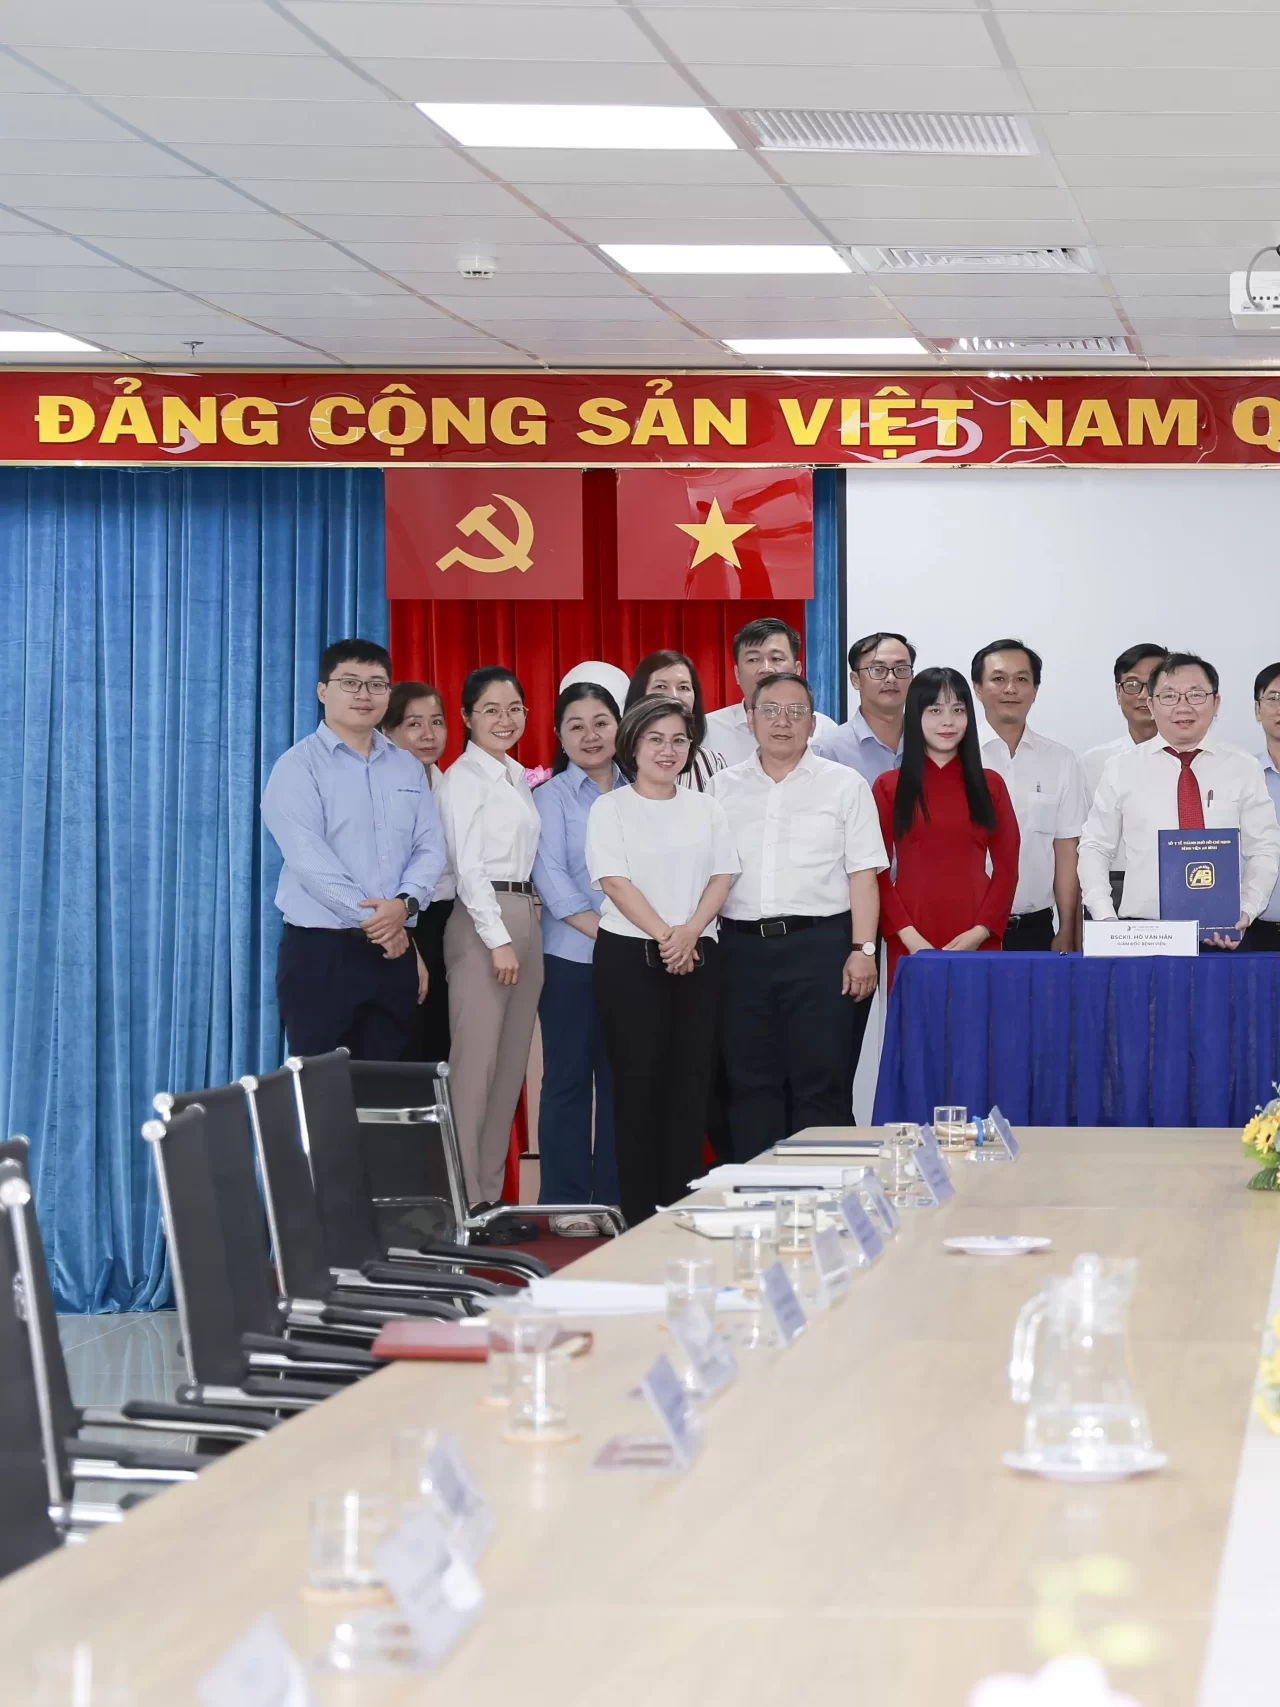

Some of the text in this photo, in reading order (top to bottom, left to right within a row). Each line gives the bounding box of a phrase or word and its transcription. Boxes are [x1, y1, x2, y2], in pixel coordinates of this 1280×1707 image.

[35, 377, 278, 444] ĐẢNG
[311, 384, 545, 456] CỘNG
[578, 378, 747, 445] SẢN
[780, 386, 973, 459] VIỆT
[1011, 399, 1198, 445] NAM
